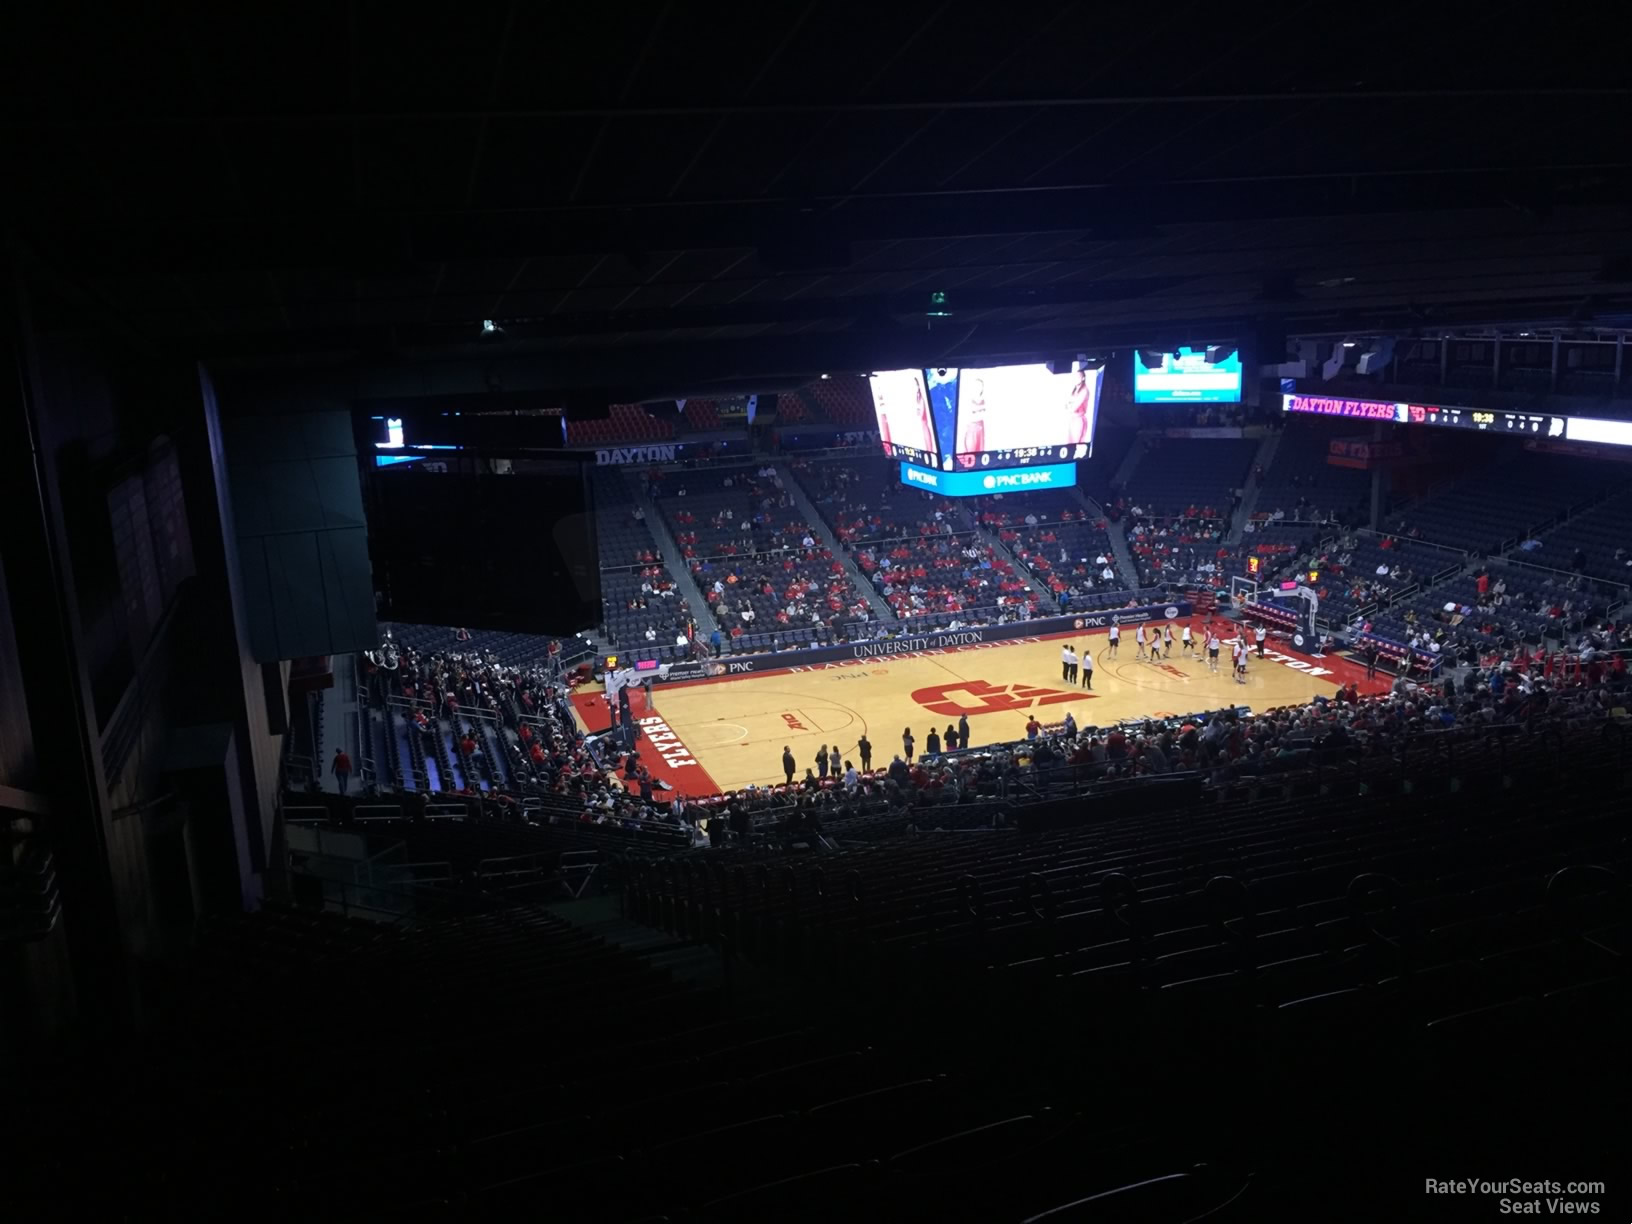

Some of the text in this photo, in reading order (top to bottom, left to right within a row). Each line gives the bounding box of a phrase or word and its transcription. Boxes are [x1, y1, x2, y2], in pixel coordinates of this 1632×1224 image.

[1293, 396, 1395, 419] DAYTON FLYERS
[596, 445, 676, 466] DAYTON
[981, 453, 989, 465] 0
[1014, 447, 1037, 458] 19:38
[1059, 446, 1068, 459] 0
[1085, 616, 1106, 627] PNC
[790, 636, 1042, 674] BLACKBURN COURT
[854, 637, 928, 658] UNIVERSITY
[939, 631, 983, 647] DAYTON
[729, 661, 753, 673] PNC
[640, 716, 697, 769] FLYERS
